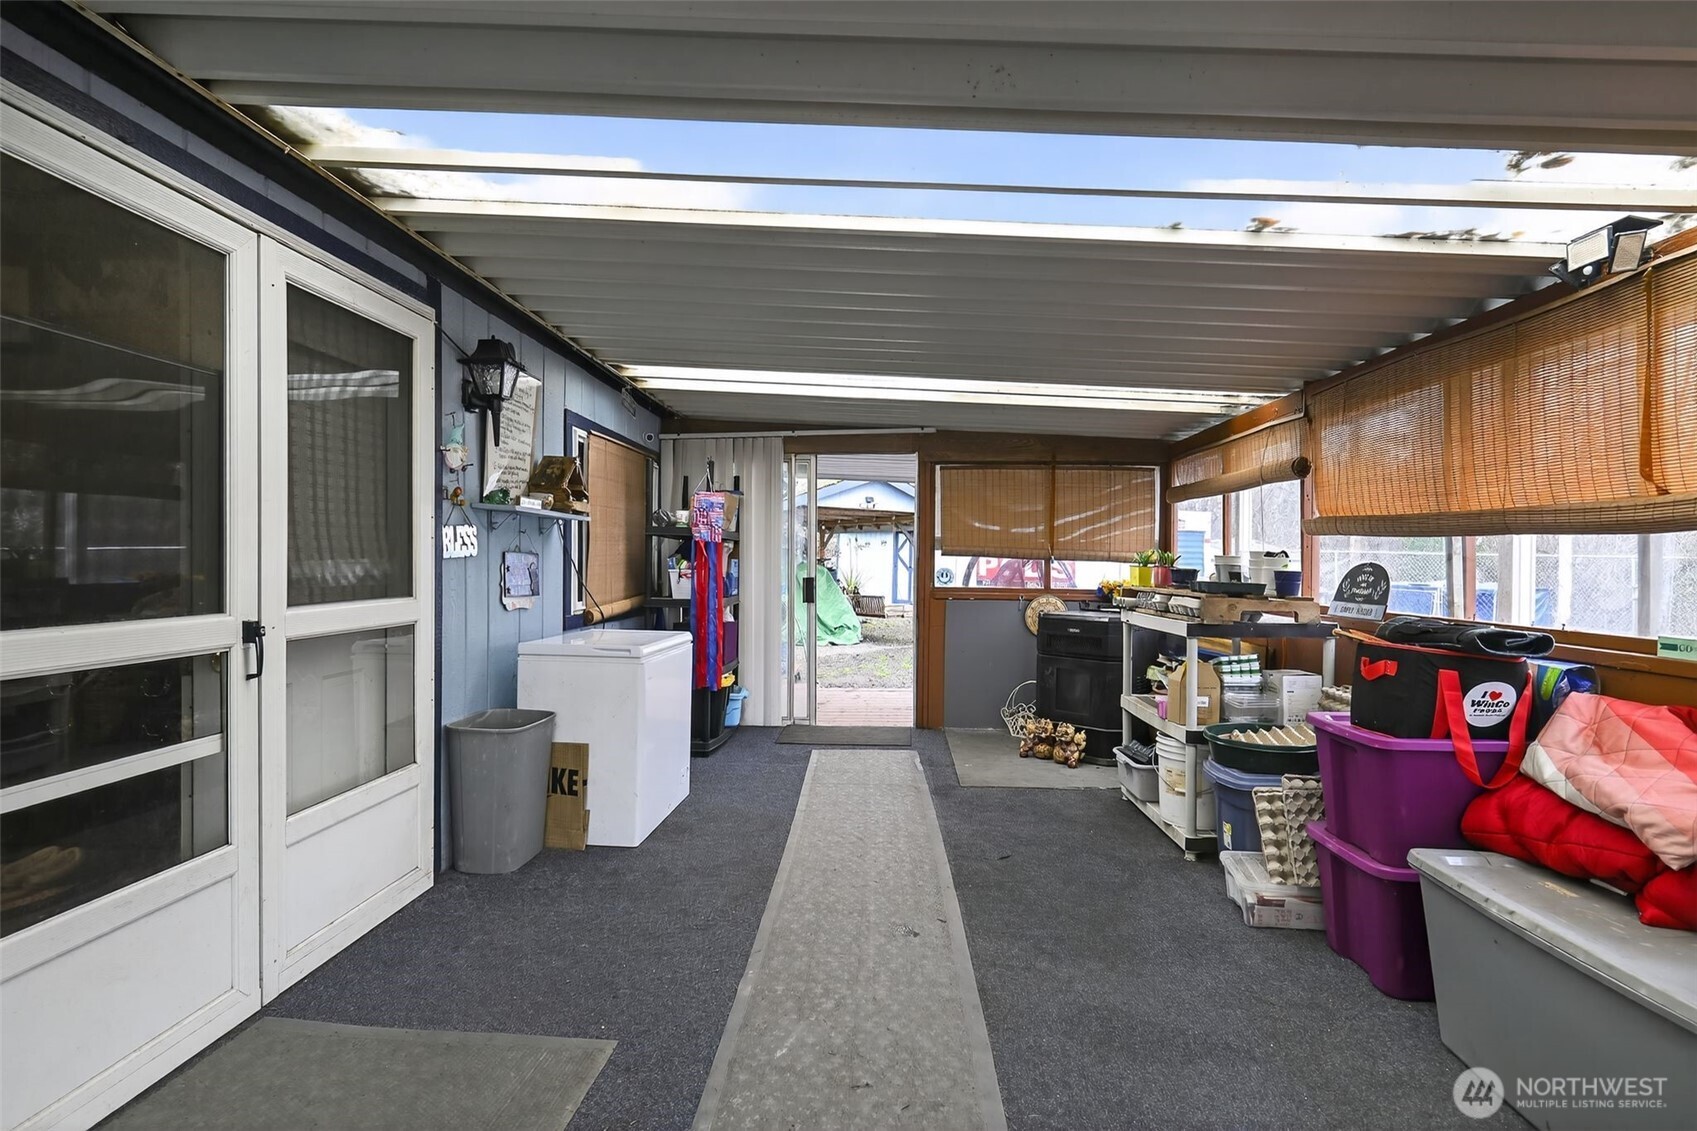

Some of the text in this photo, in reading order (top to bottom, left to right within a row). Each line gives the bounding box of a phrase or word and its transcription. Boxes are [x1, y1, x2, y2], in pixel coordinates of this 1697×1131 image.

[442, 525, 478, 559] BLESS
[1471, 699, 1510, 708] WinCo
[1481, 690, 1488, 698] I
[547, 766, 579, 797] KE
